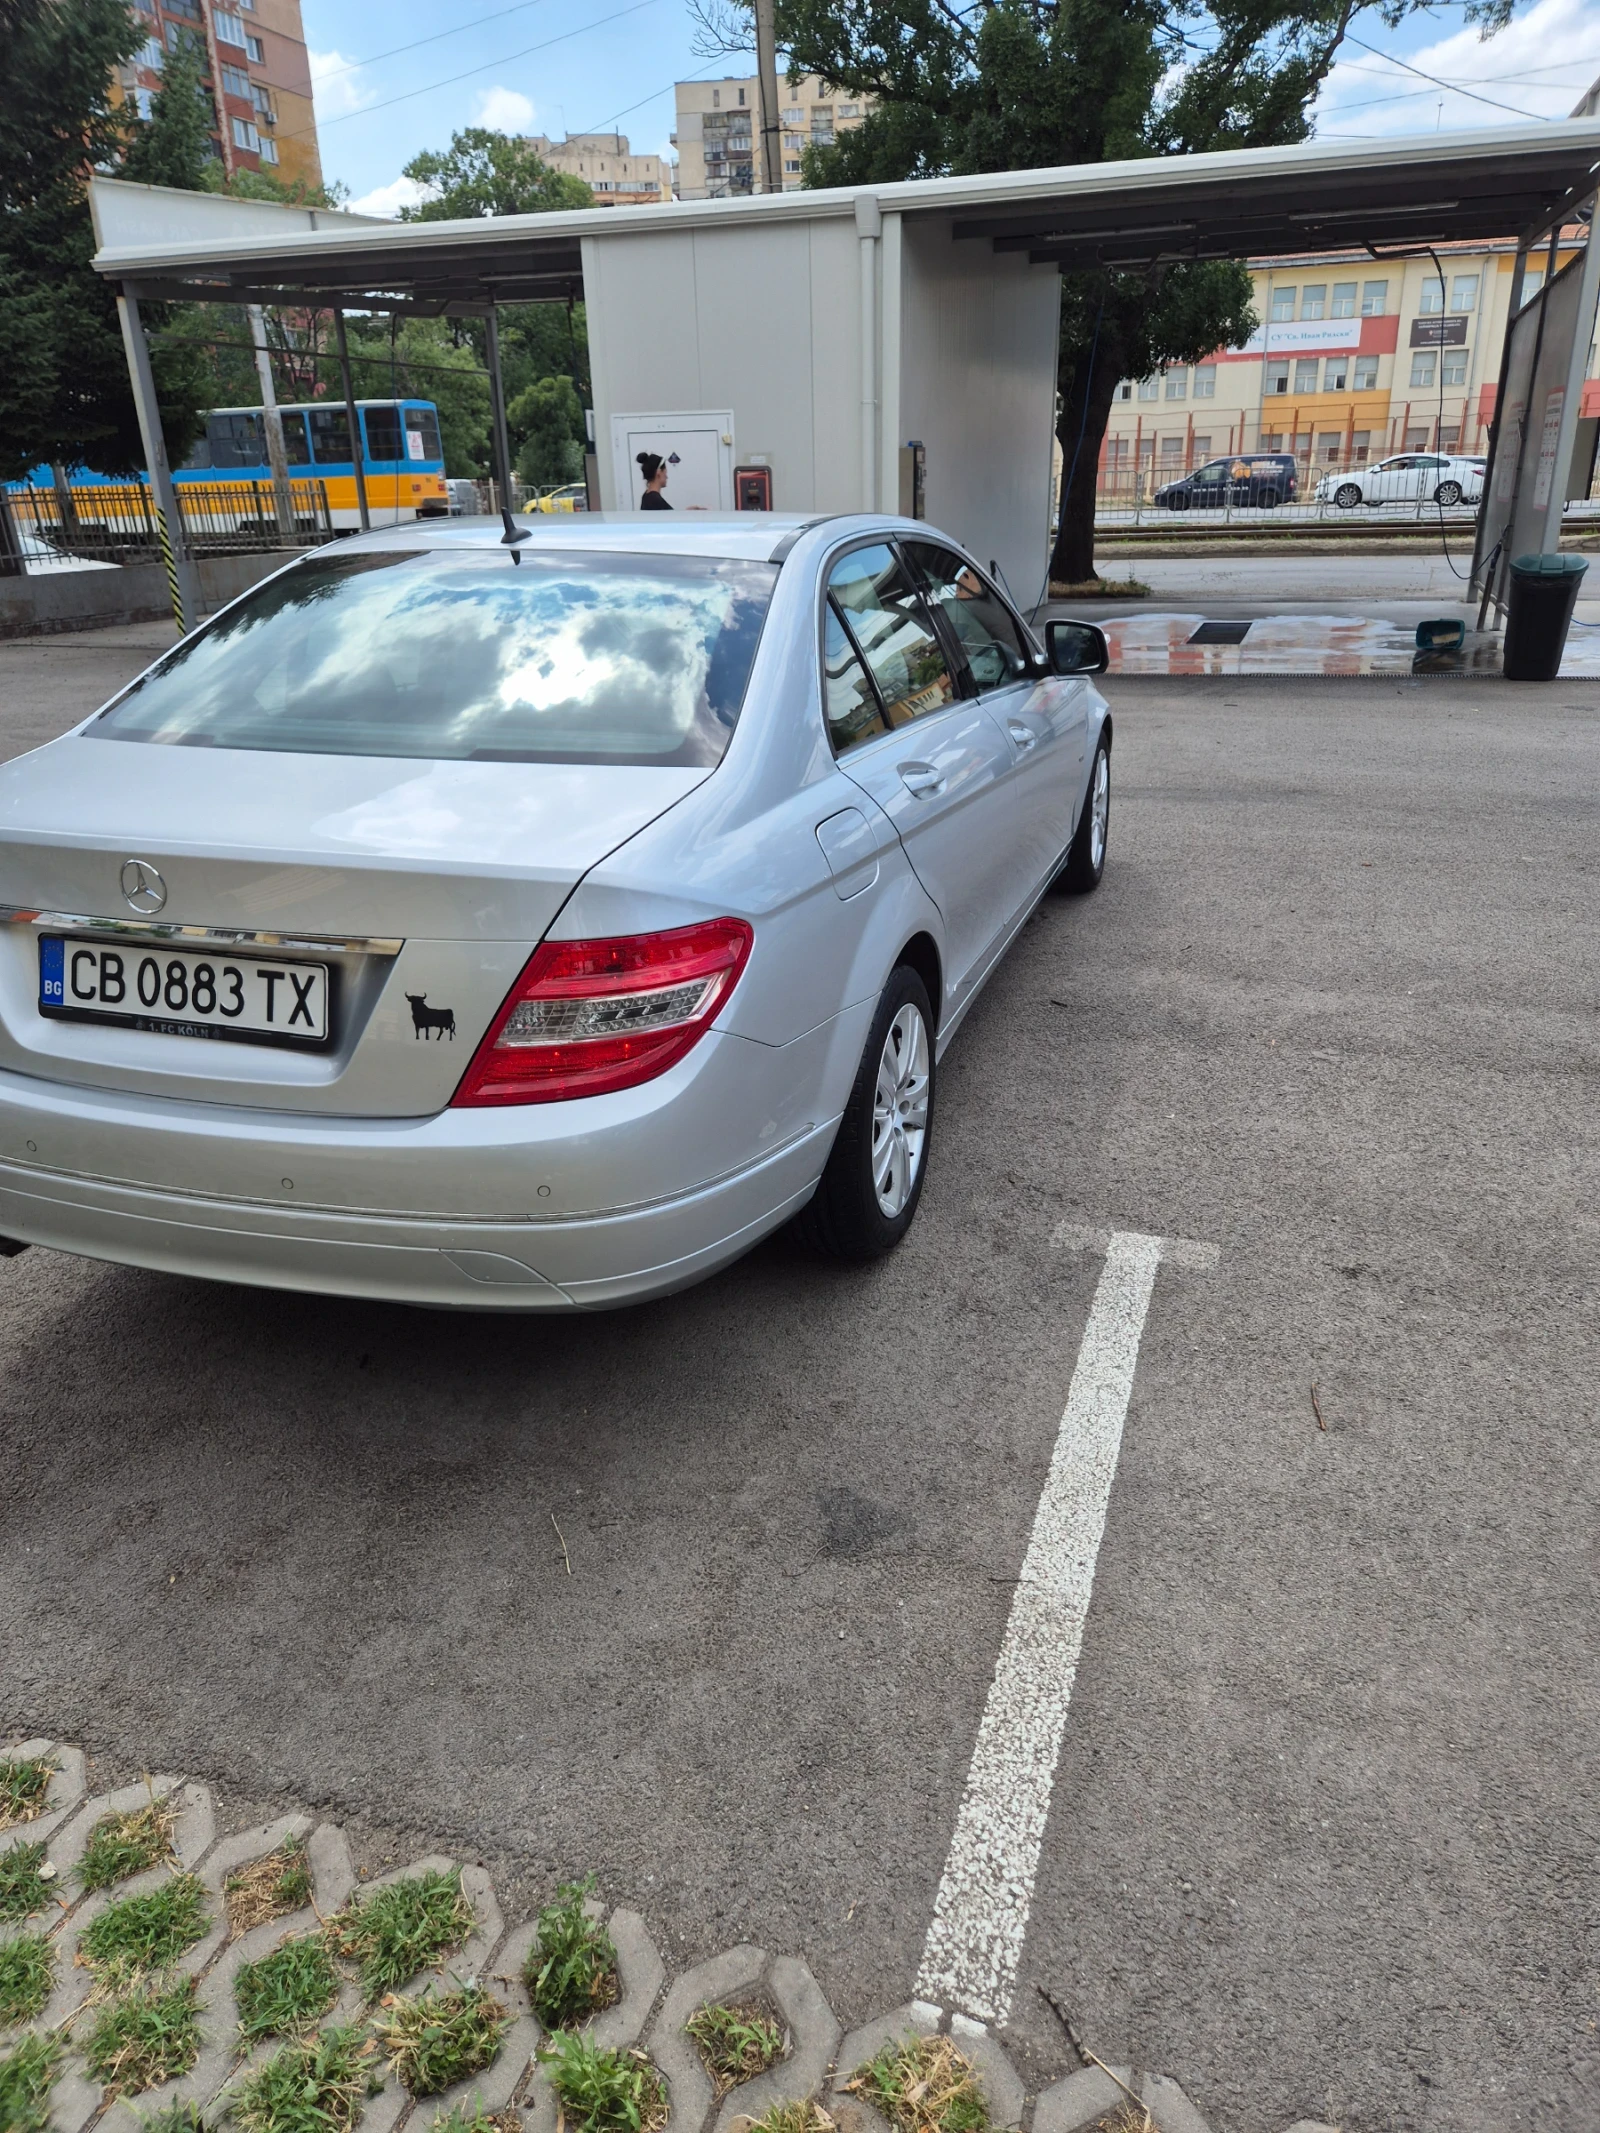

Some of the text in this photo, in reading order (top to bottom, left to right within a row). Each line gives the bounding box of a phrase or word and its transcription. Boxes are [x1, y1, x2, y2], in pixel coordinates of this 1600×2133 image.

[1271, 333, 1283, 341] СУ
[44, 980, 62, 996] BG
[71, 949, 316, 1027] CB 0883 TX
[149, 1022, 209, 1038] 1. FC KÖLN
